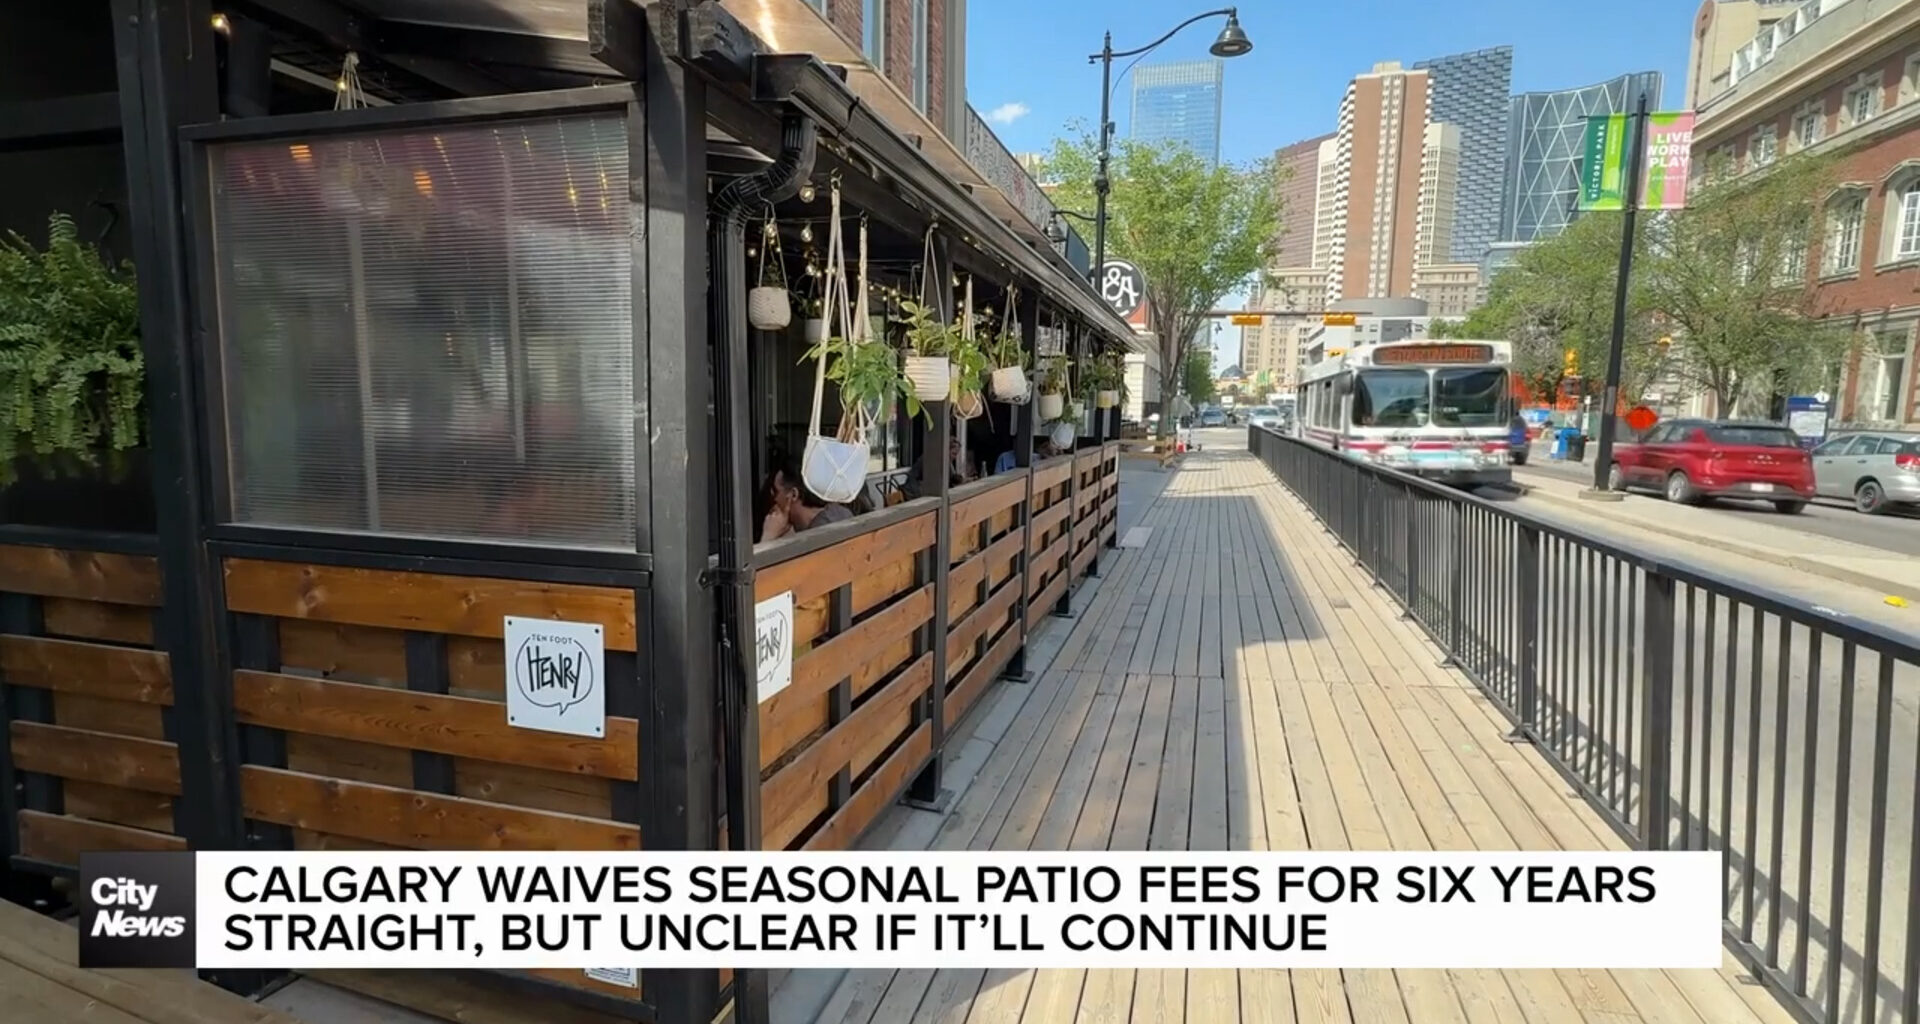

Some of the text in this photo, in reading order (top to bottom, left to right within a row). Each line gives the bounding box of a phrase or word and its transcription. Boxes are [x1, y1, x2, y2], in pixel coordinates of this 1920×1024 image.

[1656, 131, 1692, 144] LIVE
[1647, 144, 1690, 156] WORK
[1588, 123, 1606, 199] VICTORIA PARK
[1648, 156, 1689, 168] PLAY
[531, 634, 573, 644] TEN FOOT
[526, 645, 582, 698] HENRY
